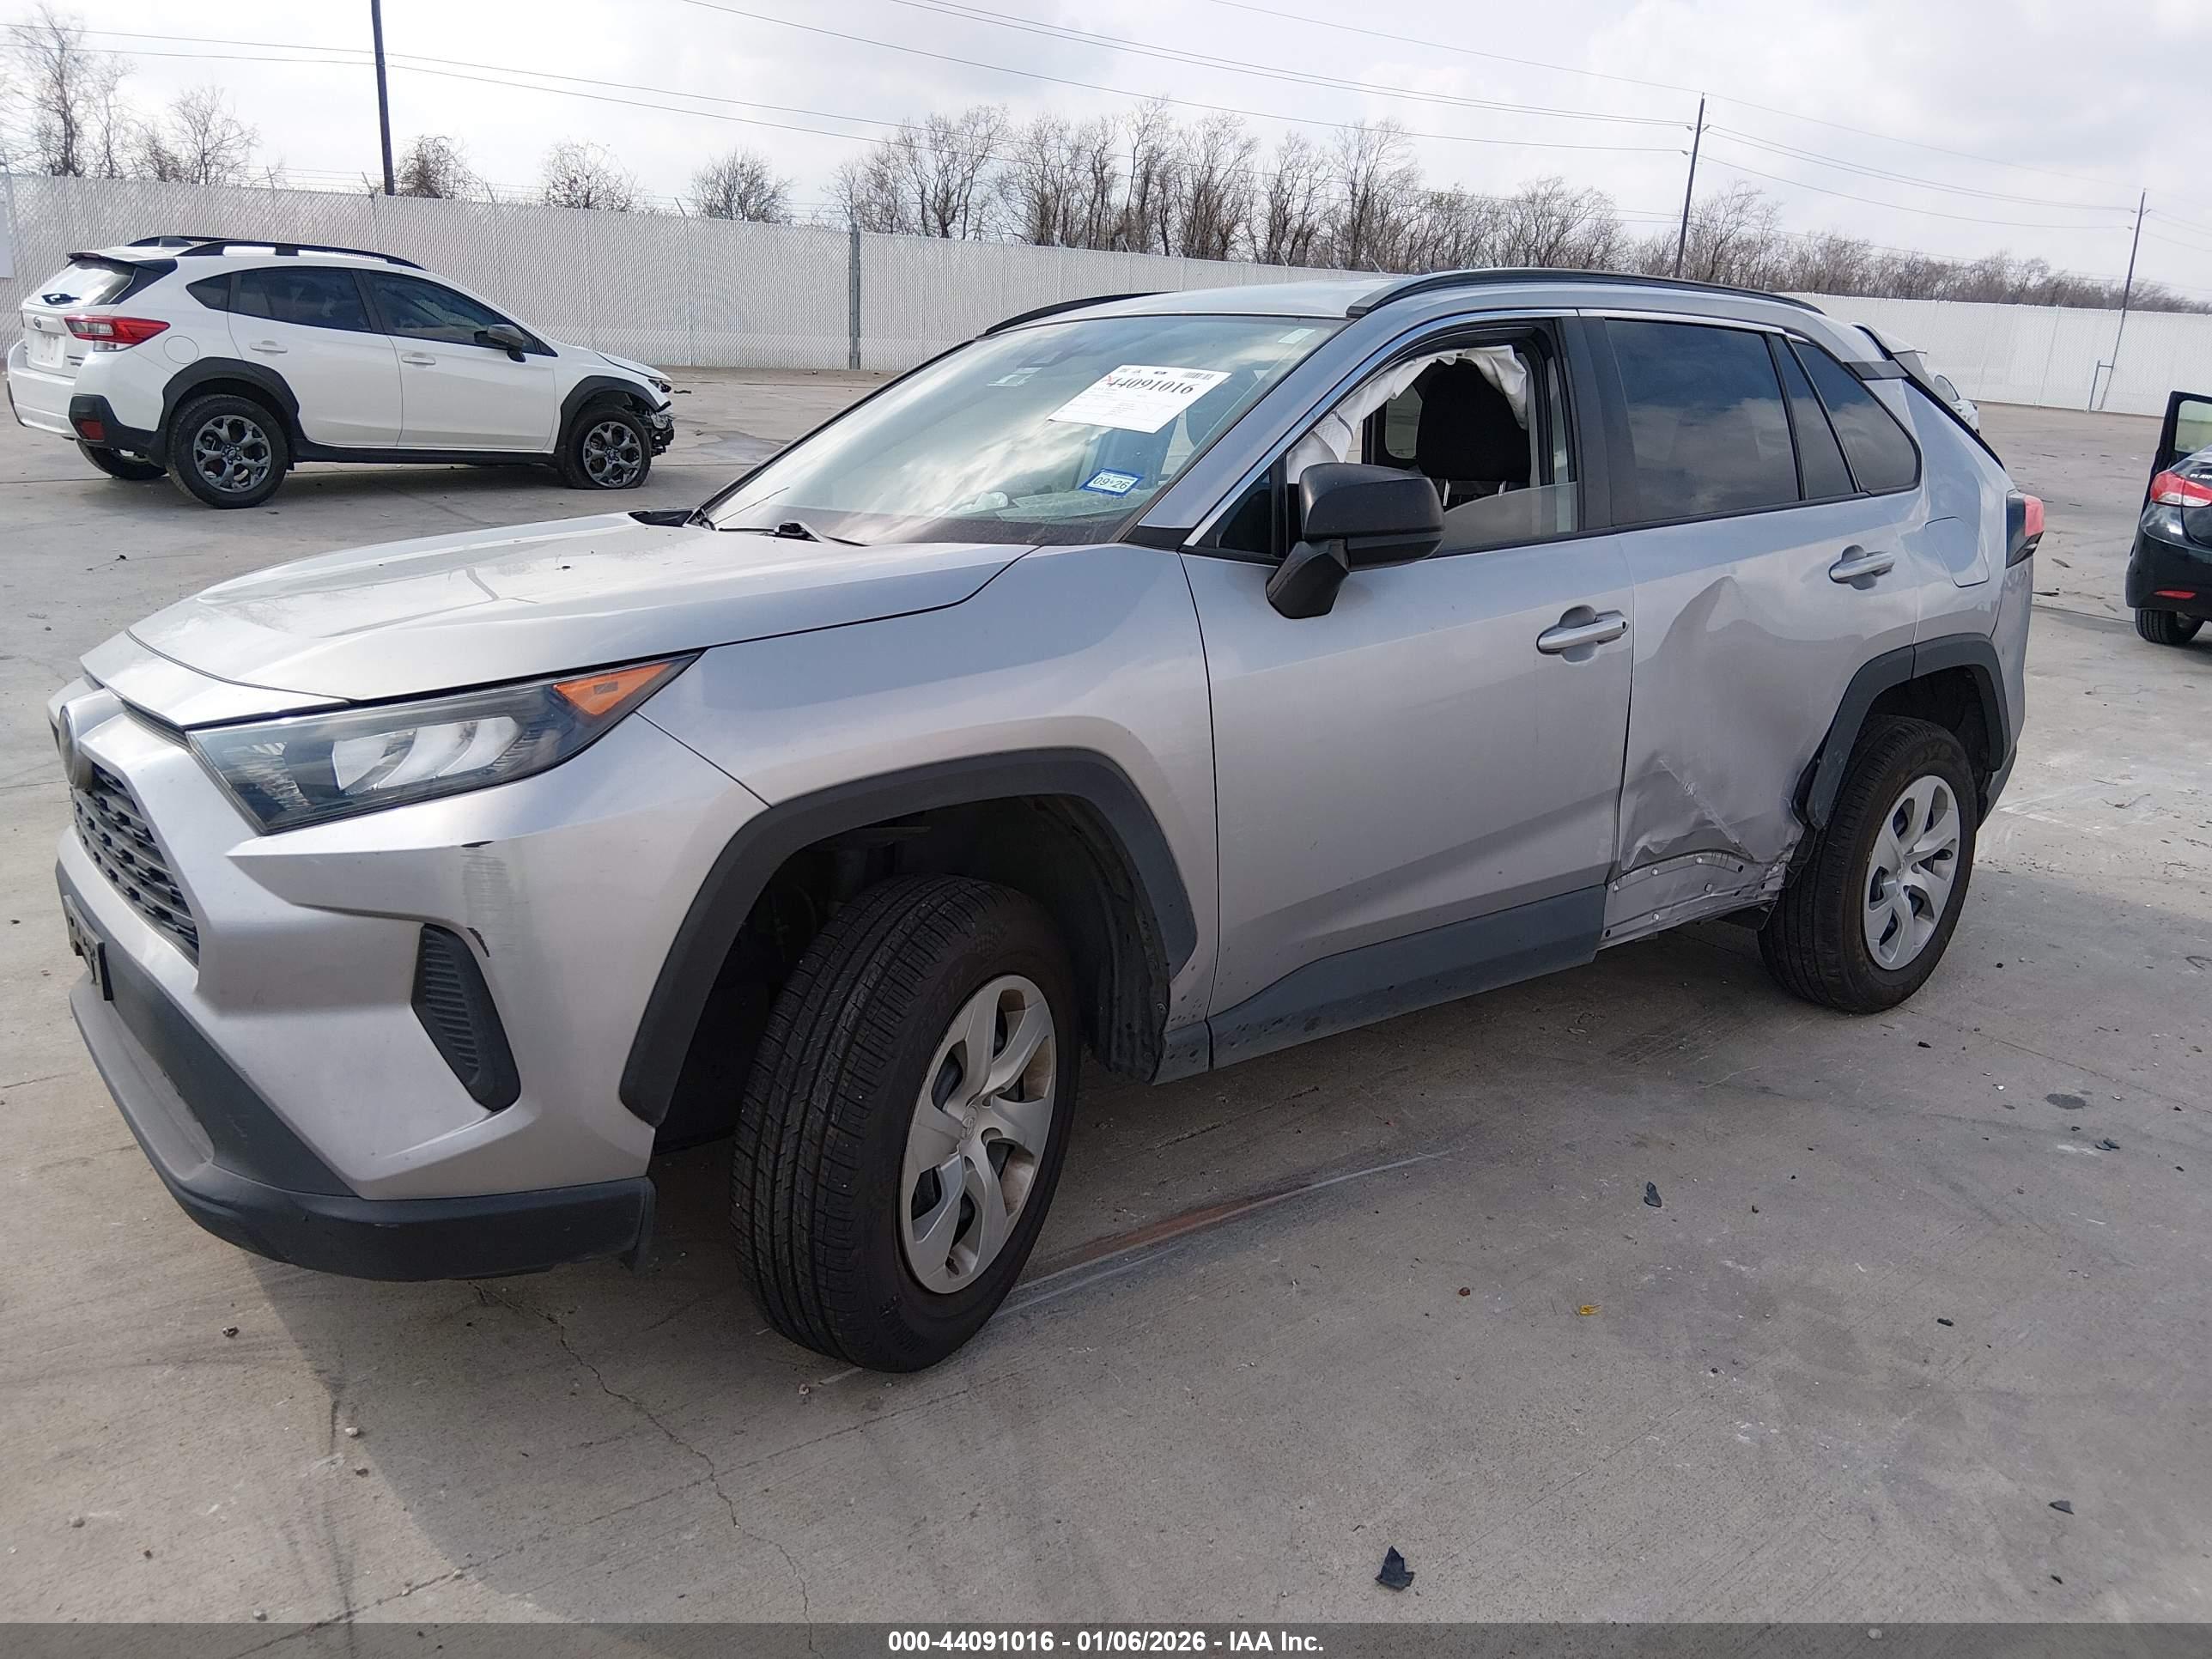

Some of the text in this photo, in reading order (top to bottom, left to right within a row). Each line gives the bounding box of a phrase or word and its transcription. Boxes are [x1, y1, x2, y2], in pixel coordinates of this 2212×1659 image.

[1106, 377, 1200, 394] 44091016
[1093, 477, 1131, 489] 09 26
